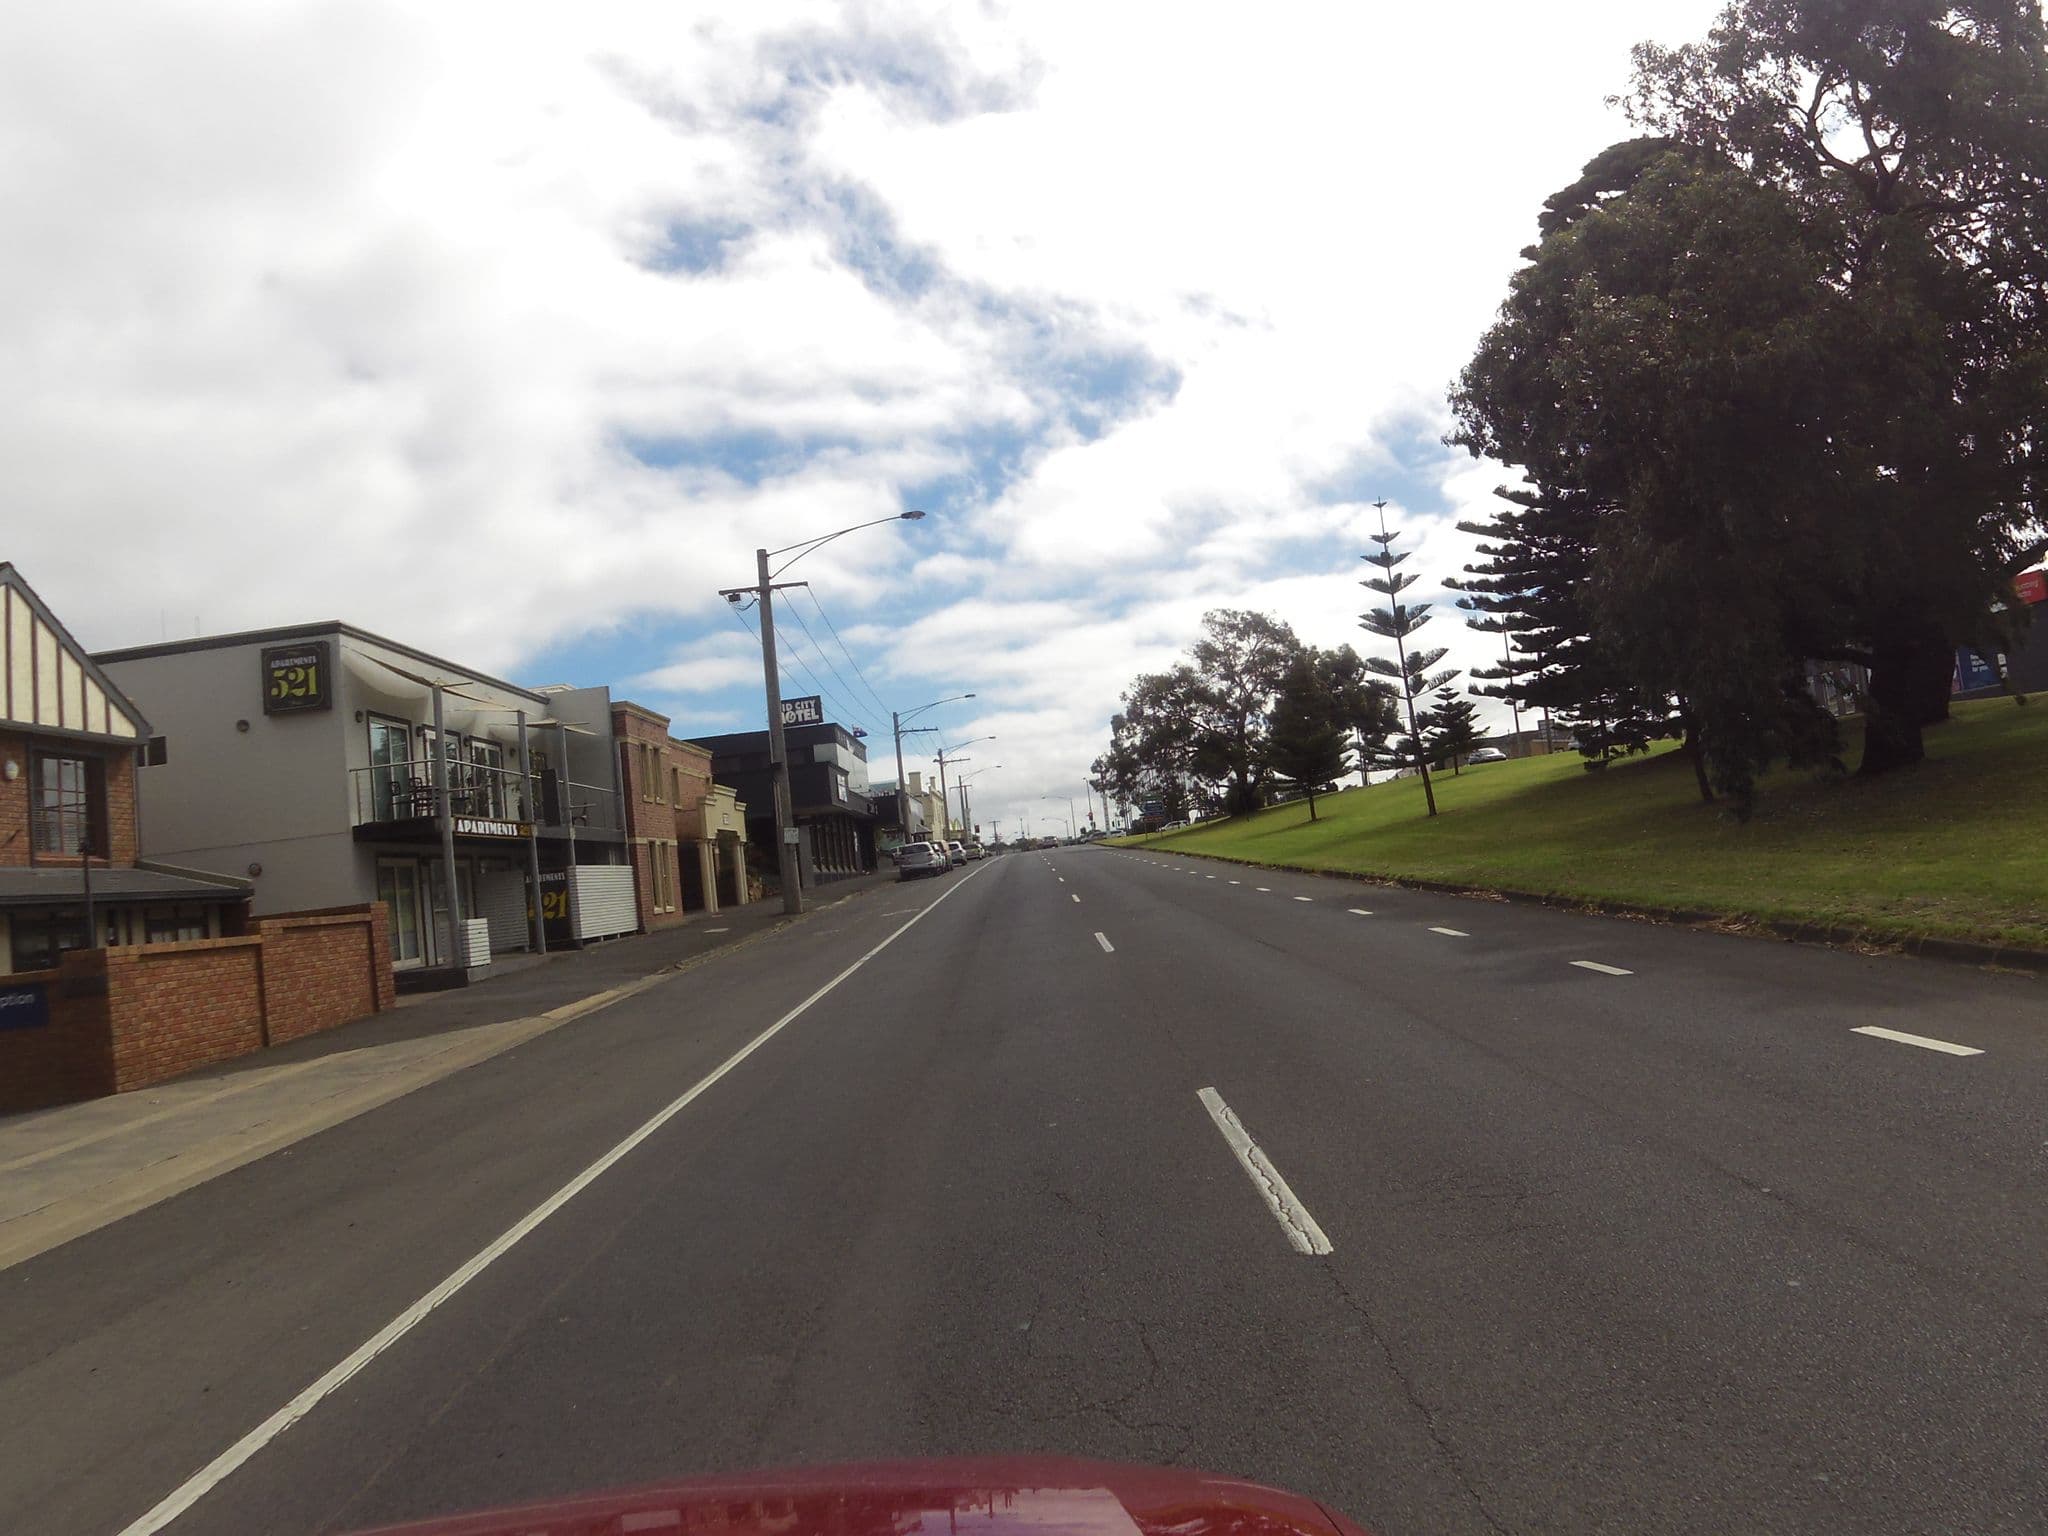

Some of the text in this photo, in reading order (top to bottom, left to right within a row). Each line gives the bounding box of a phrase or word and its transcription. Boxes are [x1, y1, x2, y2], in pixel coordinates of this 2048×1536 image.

[271, 666, 318, 699] 521
[795, 699, 816, 710] CITY
[457, 819, 518, 836] APARTMENTS
